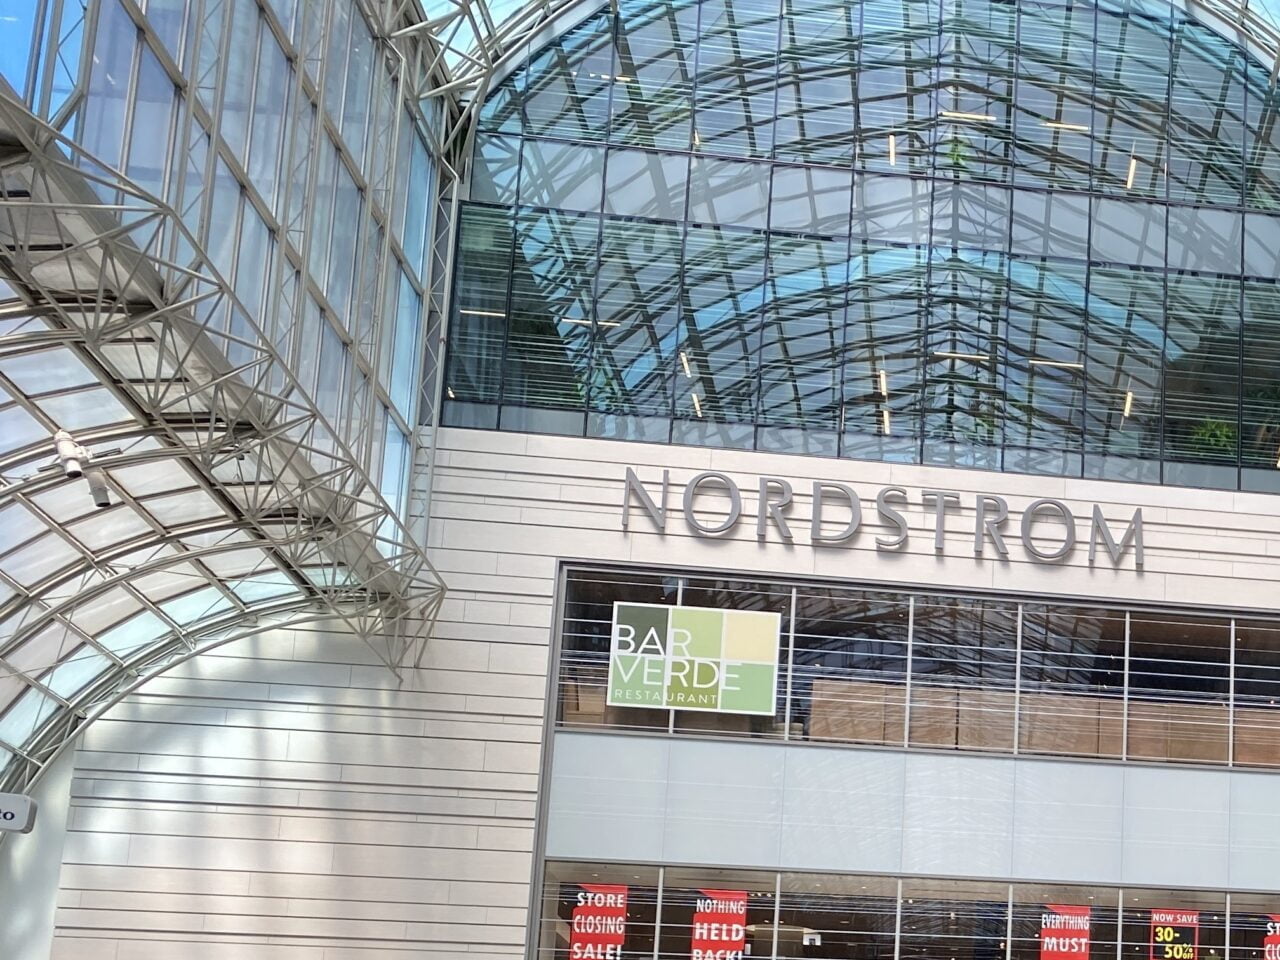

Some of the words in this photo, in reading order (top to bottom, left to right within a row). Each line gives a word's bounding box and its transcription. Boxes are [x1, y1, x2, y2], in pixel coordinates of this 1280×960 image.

[621, 466, 1144, 566] NORDSTROM
[614, 624, 693, 658] BAR
[614, 655, 743, 691] VERDE
[614, 689, 717, 705] RESTAURANT
[577, 892, 625, 909] STORE
[696, 898, 745, 915] NOTHING
[573, 914, 625, 934] CLOSING
[1041, 913, 1089, 930] EVERYTHING
[1152, 913, 1174, 922] NOW
[1176, 914, 1198, 924] SAVE
[694, 922, 744, 941] HELD
[1155, 927, 1180, 942] 30-
[573, 942, 622, 960] SALE!
[1043, 937, 1088, 953] MUST
[1163, 943, 1193, 960] 50%
